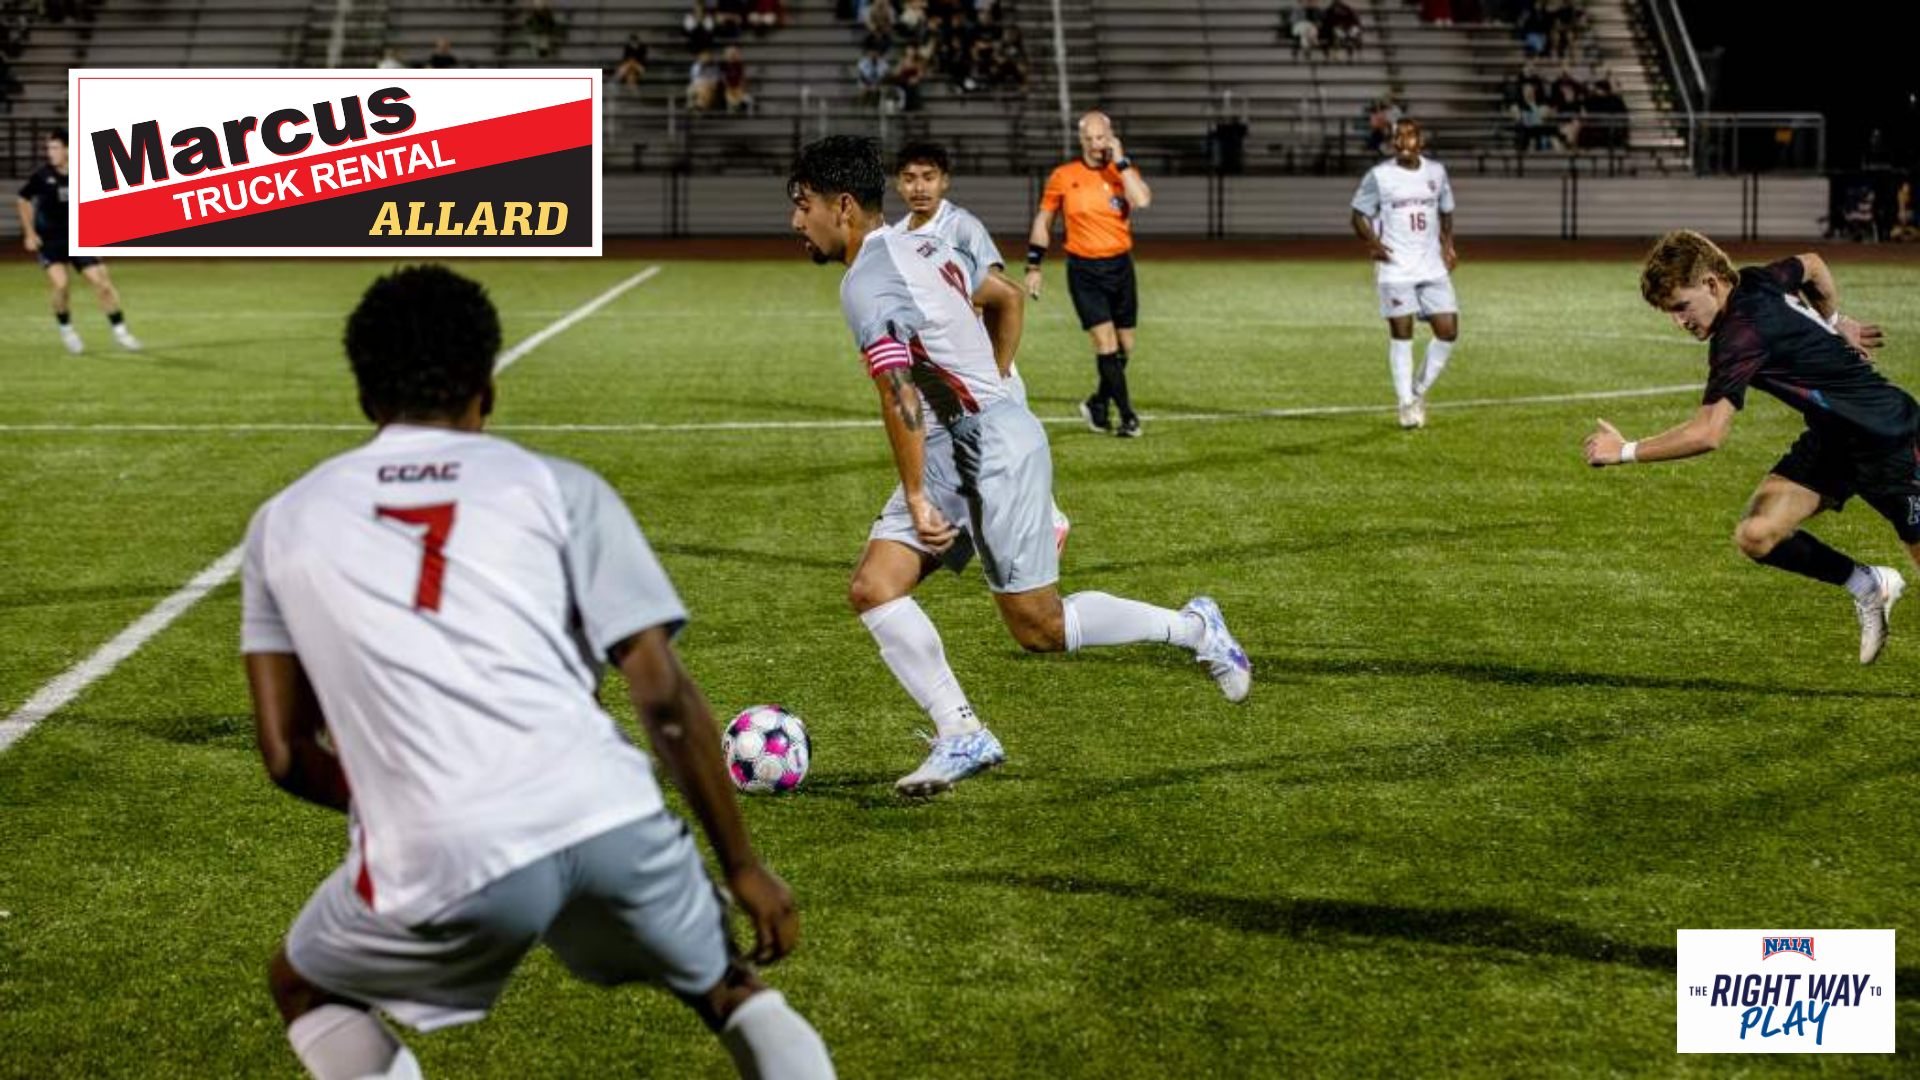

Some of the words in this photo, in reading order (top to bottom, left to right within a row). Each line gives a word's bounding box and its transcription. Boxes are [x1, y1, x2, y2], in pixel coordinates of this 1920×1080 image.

[1409, 211, 1427, 232] 16
[377, 462, 461, 483] CCAC
[374, 500, 456, 614] 7
